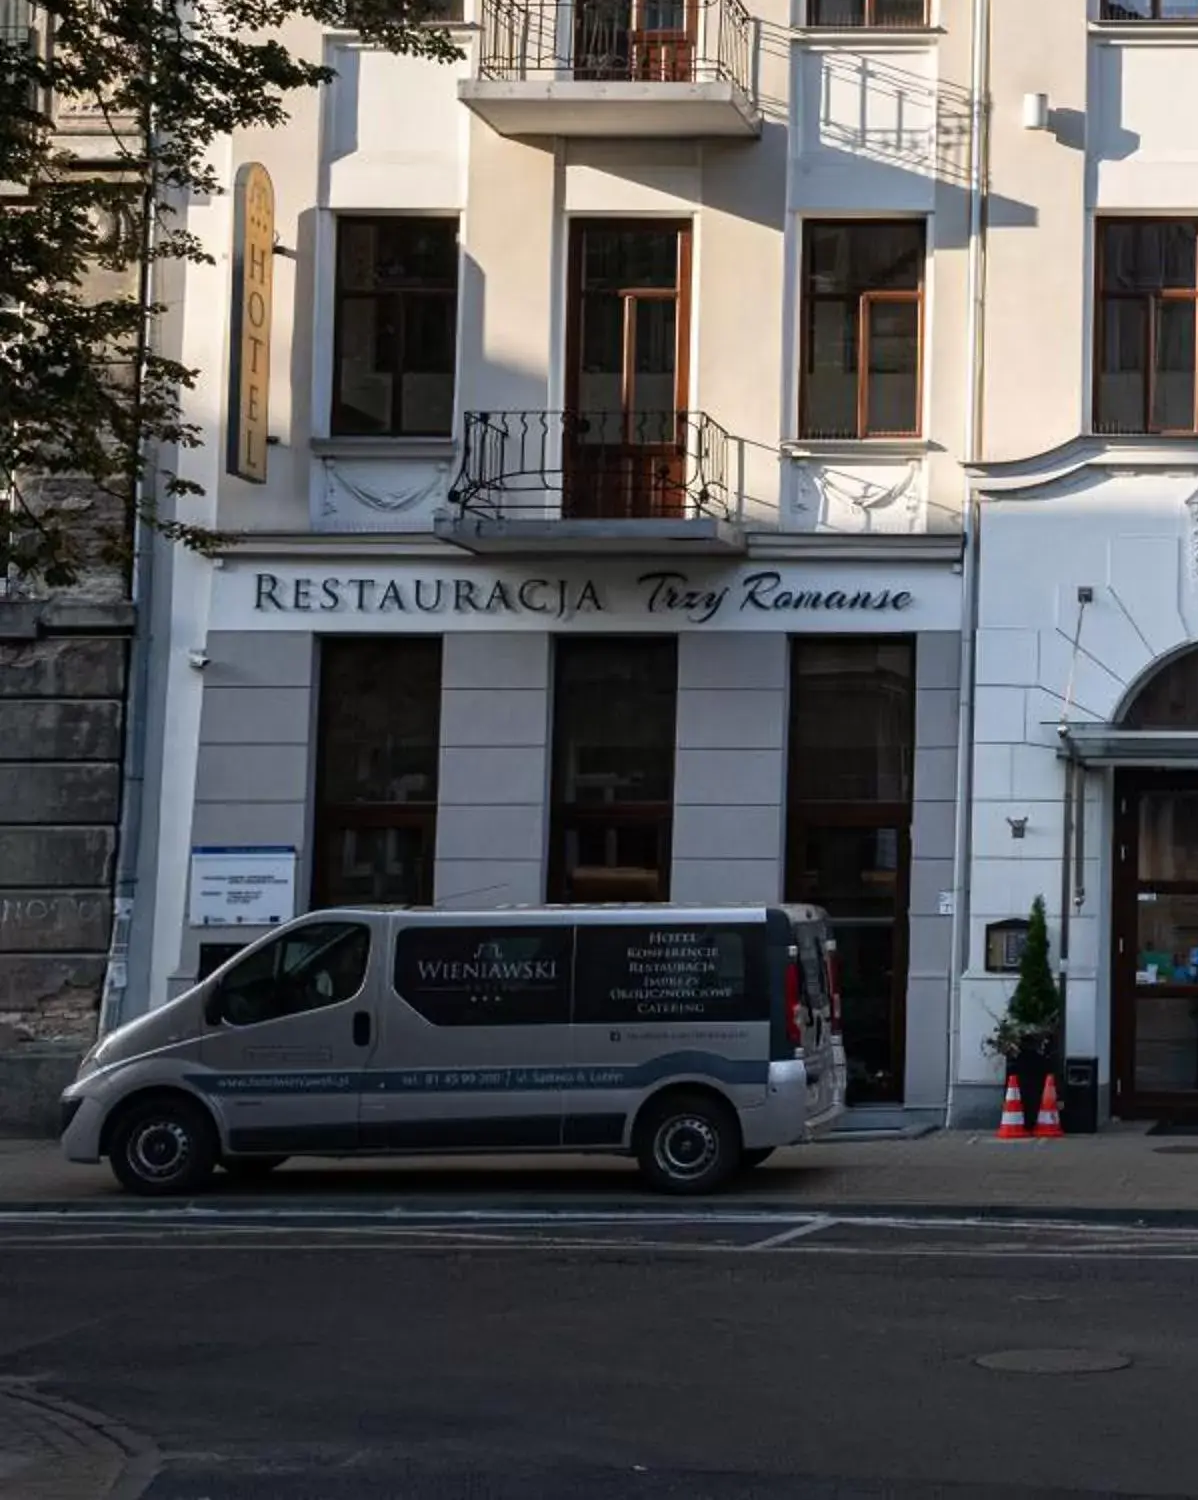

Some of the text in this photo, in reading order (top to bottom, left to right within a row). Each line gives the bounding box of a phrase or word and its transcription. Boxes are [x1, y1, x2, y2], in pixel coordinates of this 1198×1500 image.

[246, 243, 266, 469] HOTEL
[254, 571, 914, 624] RESTAURACJA Trzy Romanse
[417, 959, 558, 981] WIENIAWSKI
